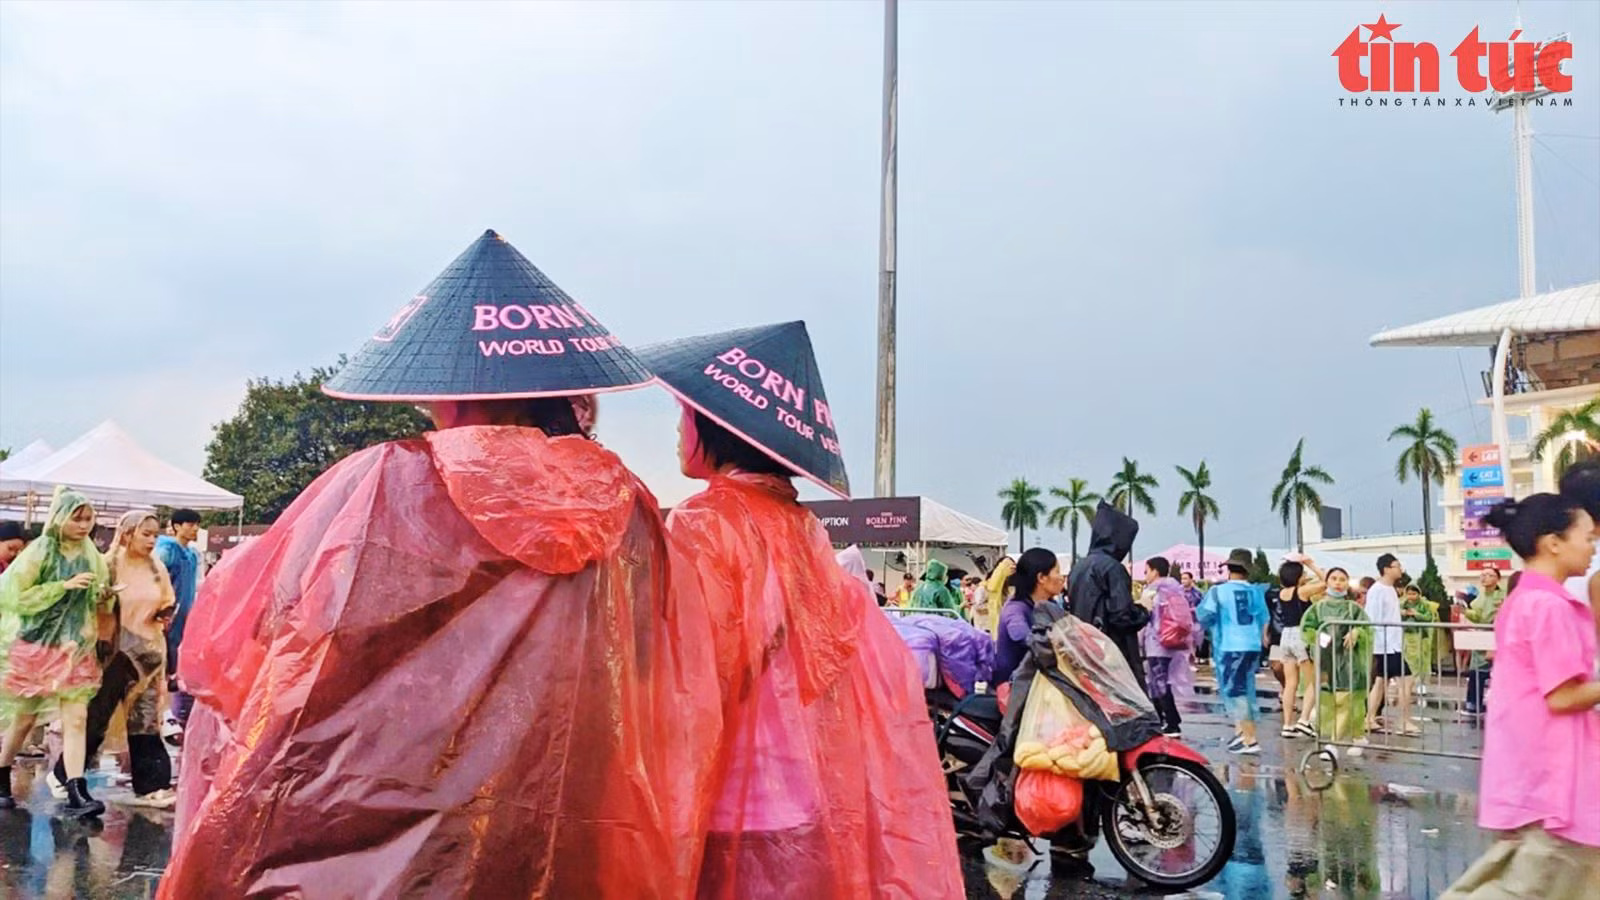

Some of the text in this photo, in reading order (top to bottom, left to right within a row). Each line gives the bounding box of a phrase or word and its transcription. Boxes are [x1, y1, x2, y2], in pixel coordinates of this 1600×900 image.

[472, 303, 585, 331] BORN
[479, 339, 564, 357] WORLD
[703, 363, 768, 410] WORLD
[776, 406, 814, 441] TOUR
[716, 347, 805, 411] BORN
